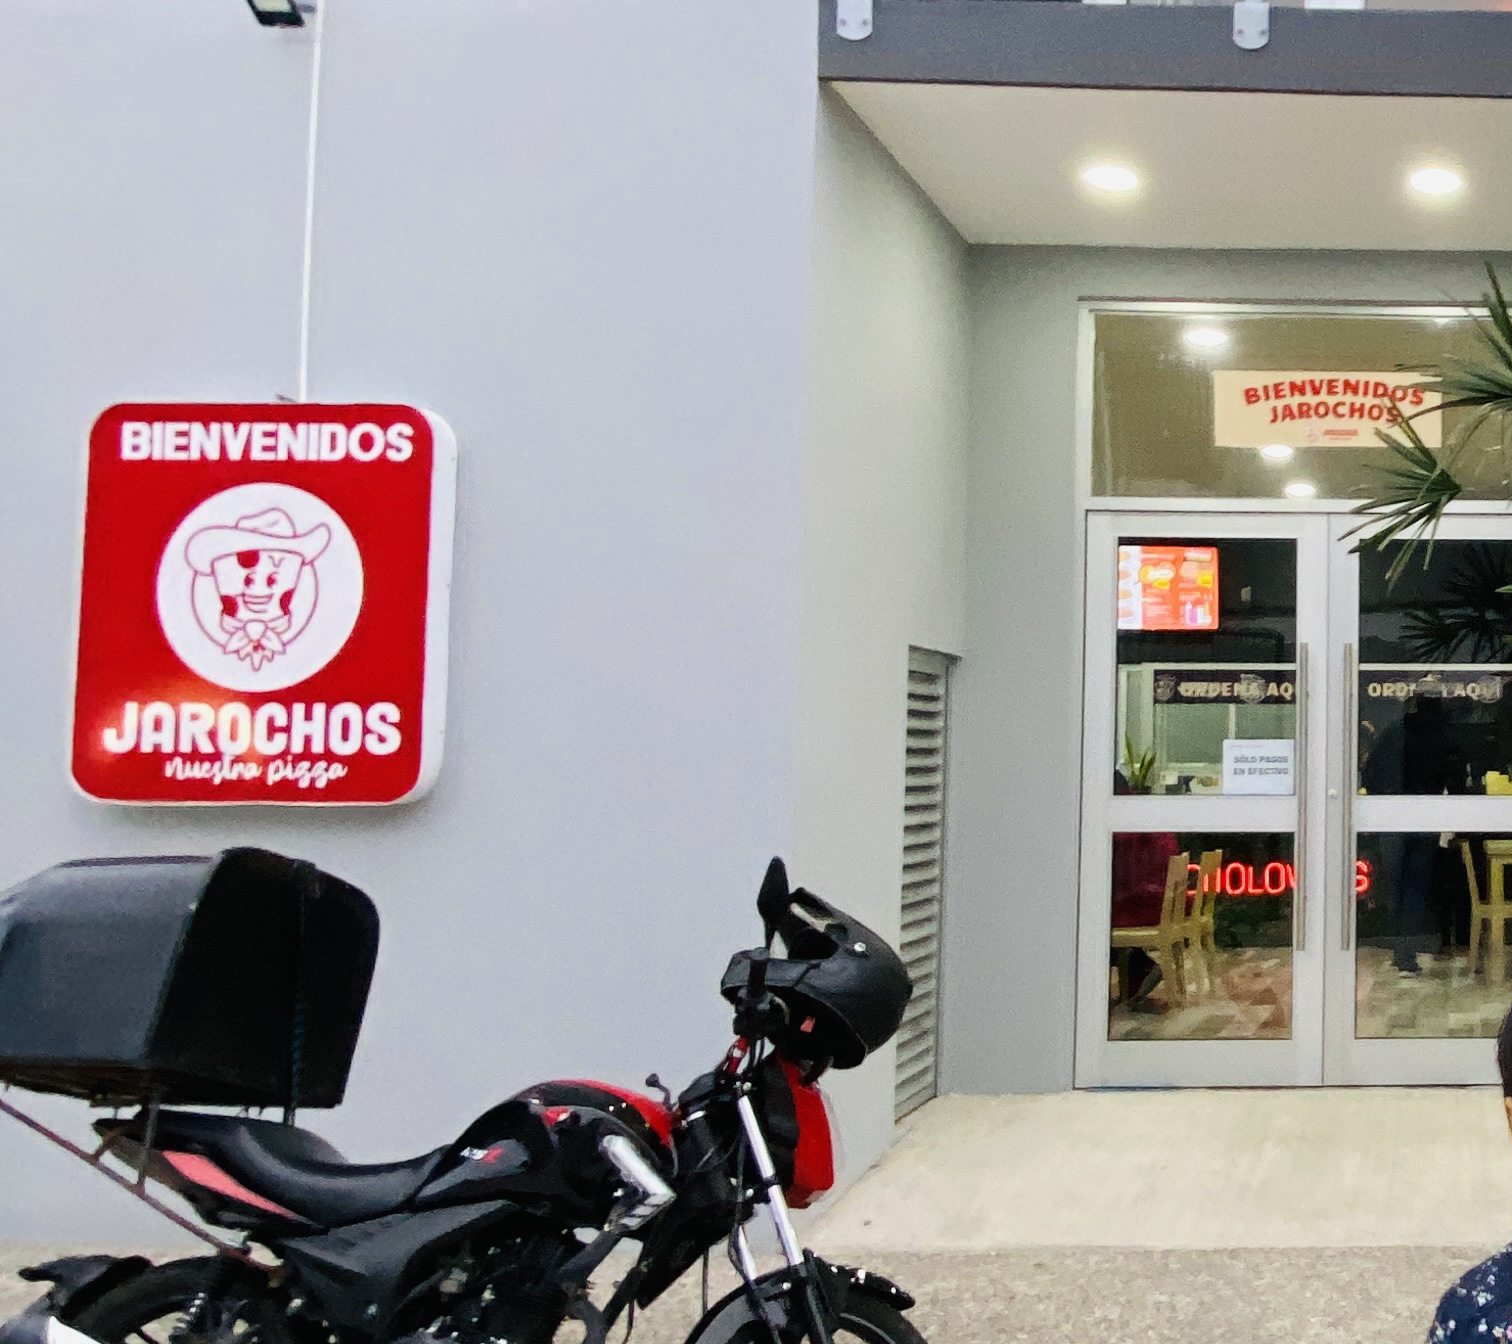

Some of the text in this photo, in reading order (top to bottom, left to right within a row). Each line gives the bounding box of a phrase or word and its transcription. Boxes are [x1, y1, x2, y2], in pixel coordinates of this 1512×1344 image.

[1243, 378, 1426, 406] BIENVENIDOS
[1269, 400, 1401, 425] JAROCHOS
[120, 420, 415, 462] BIENVENIDOS
[1266, 682, 1294, 700] AQ
[102, 701, 402, 756] JAROCHOS
[1233, 767, 1246, 776] EN
